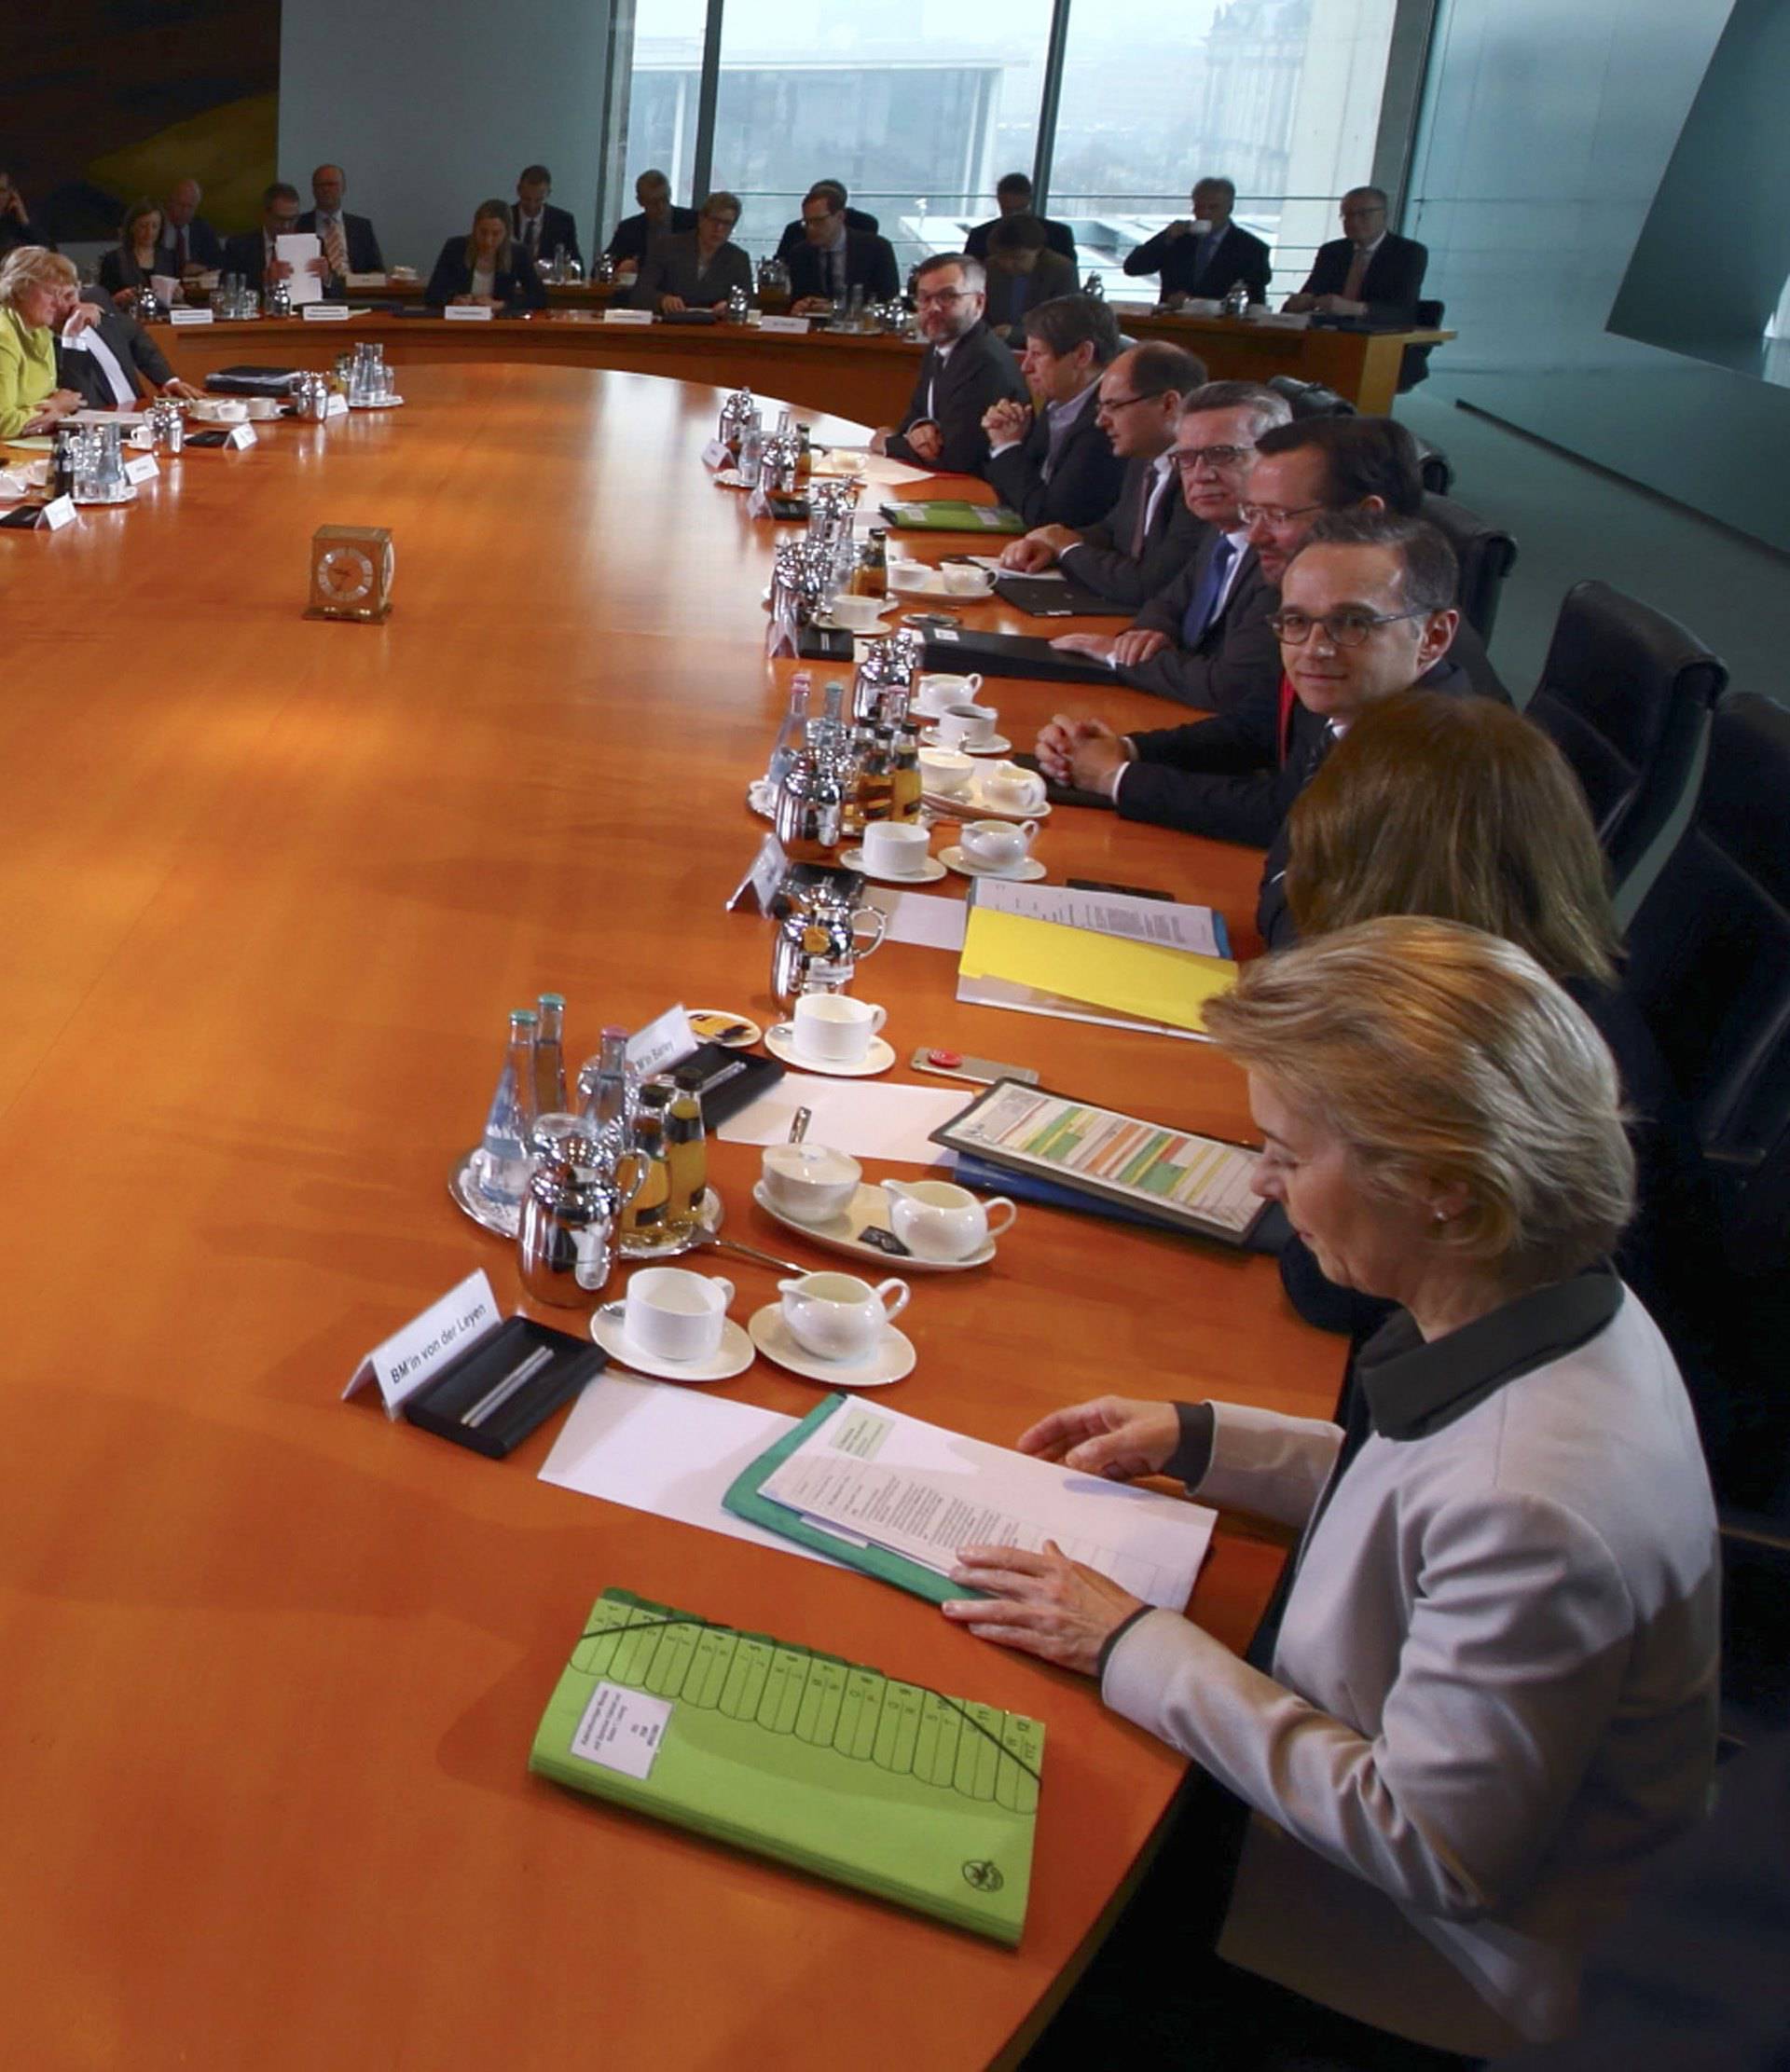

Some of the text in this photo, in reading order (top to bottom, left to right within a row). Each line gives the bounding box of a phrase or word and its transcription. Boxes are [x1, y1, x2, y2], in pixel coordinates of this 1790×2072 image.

[391, 1304, 487, 1384] BM'in von der Leyen
